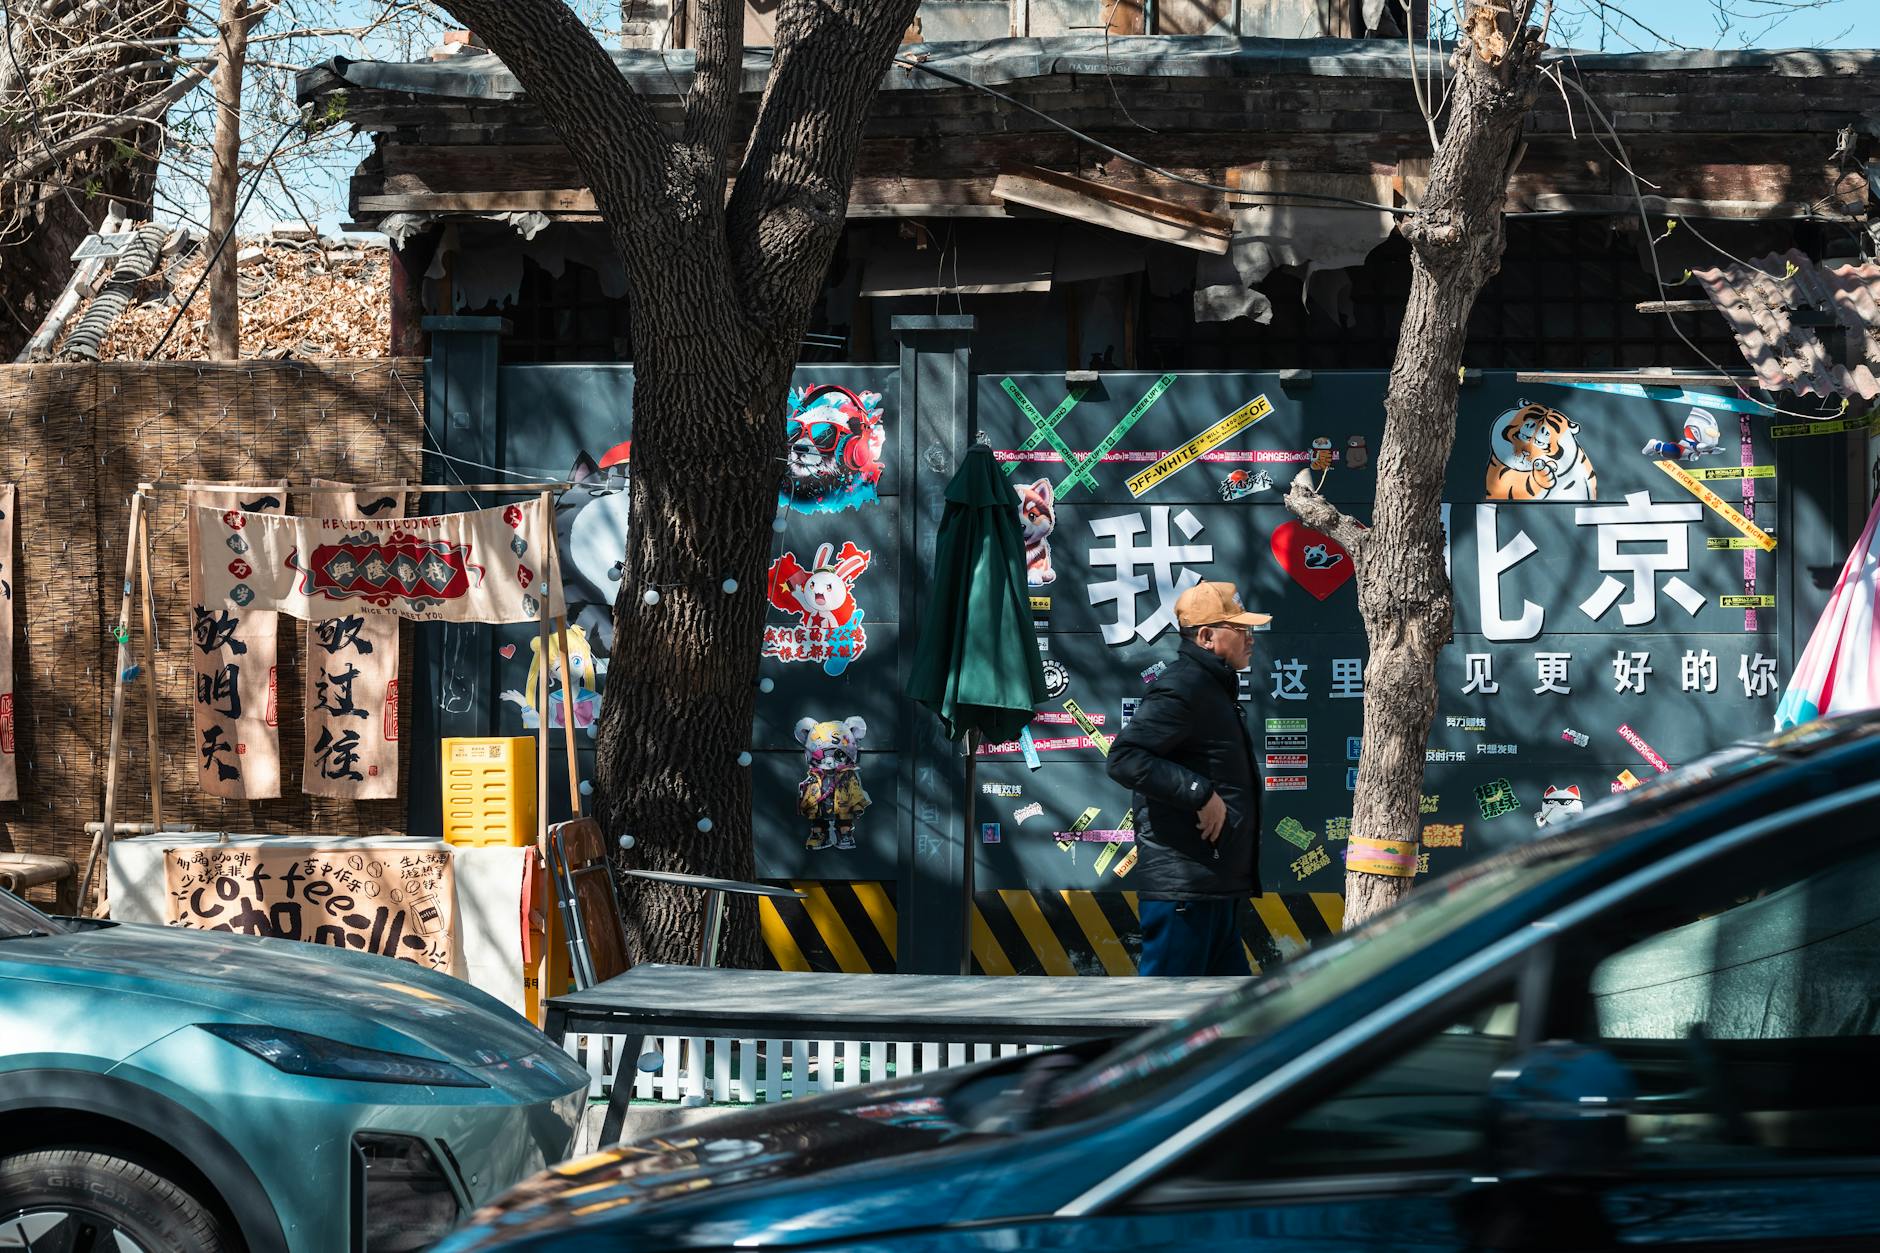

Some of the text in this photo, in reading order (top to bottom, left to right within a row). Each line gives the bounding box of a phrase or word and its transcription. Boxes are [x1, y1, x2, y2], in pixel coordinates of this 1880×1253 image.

[1008, 385, 1026, 405] CHEER
[1131, 388, 1159, 418] CHEER UP!
[1249, 399, 1267, 417] OF
[1074, 455, 1093, 477] CHEER
[1257, 452, 1290, 461] DANGER
[1662, 460, 1695, 488] GET RICH
[1730, 514, 1764, 541] GET RICH
[361, 607, 443, 620] NICE TO MEET YOU
[1425, 751, 1466, 762] 及时行乐
[304, 857, 363, 894] 苦中作乐
[1116, 858, 1133, 876] RICH
